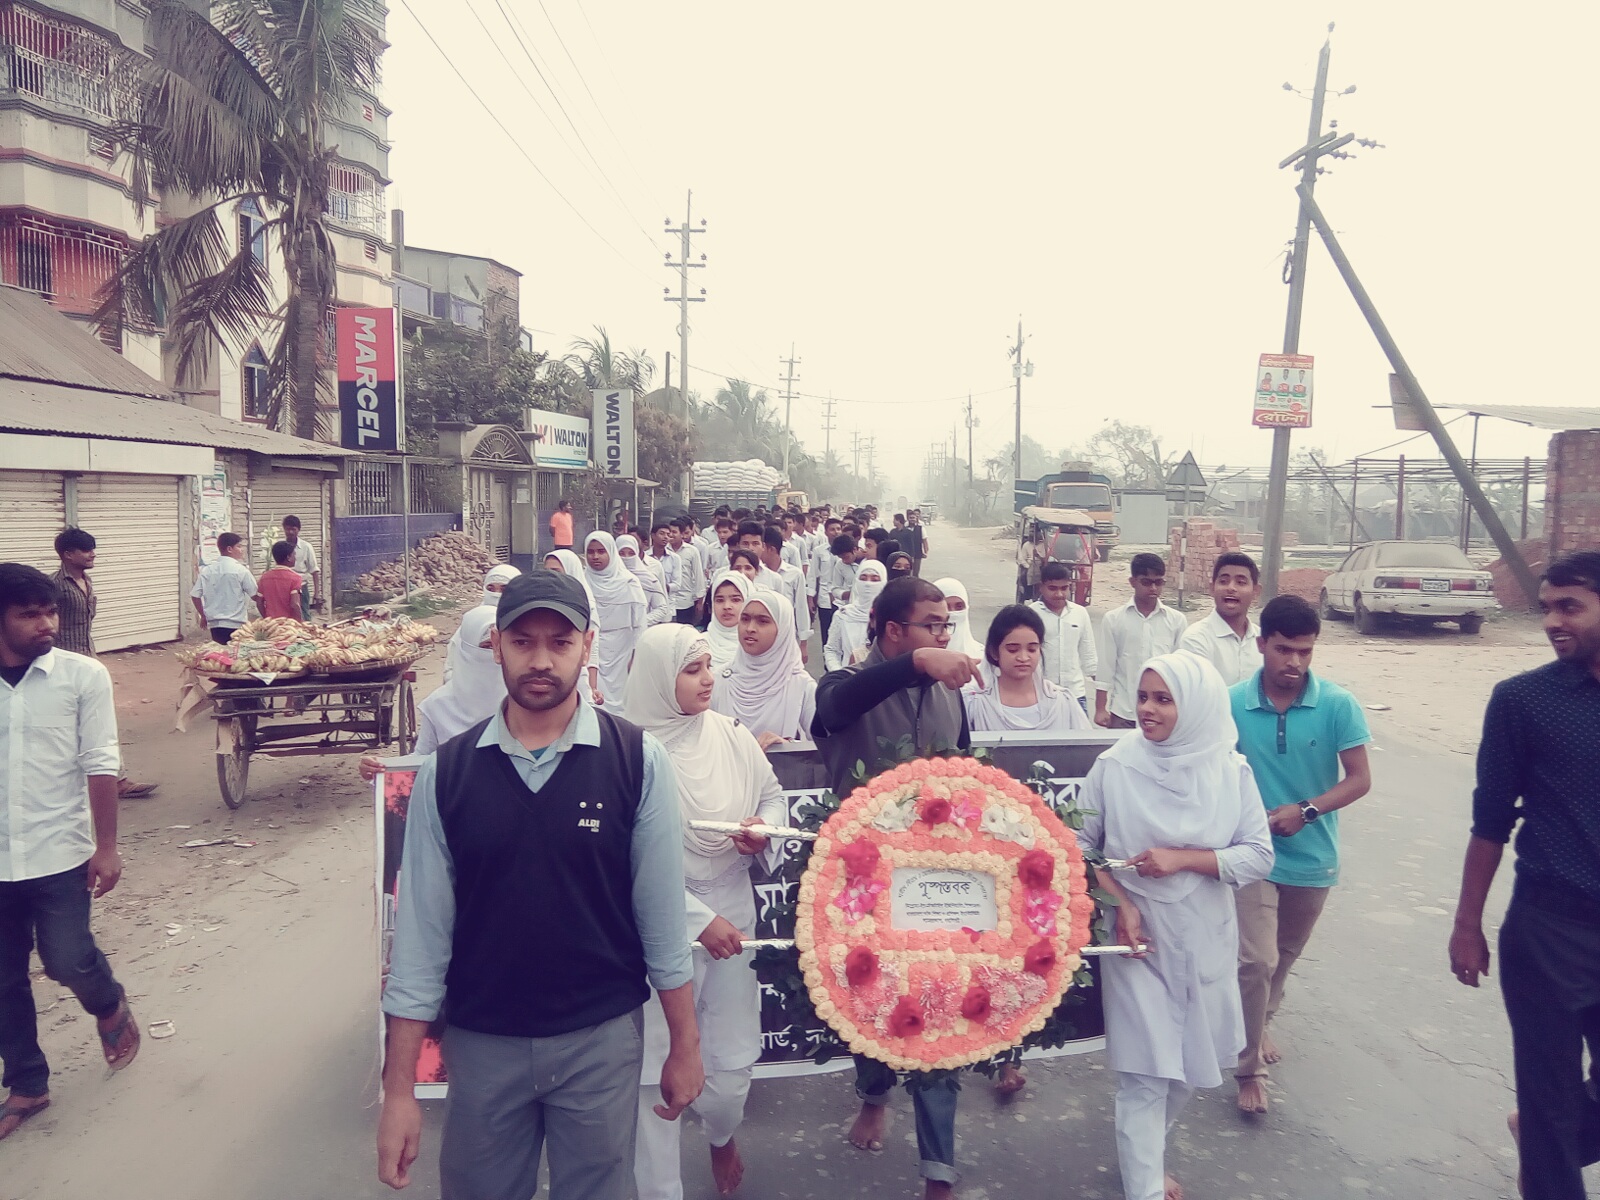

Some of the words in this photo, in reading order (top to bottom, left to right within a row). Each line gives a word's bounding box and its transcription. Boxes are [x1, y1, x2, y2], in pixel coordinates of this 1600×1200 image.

[354, 315, 380, 446] MARCEL
[554, 427, 587, 448] WALTON
[606, 392, 621, 475] WALTON
